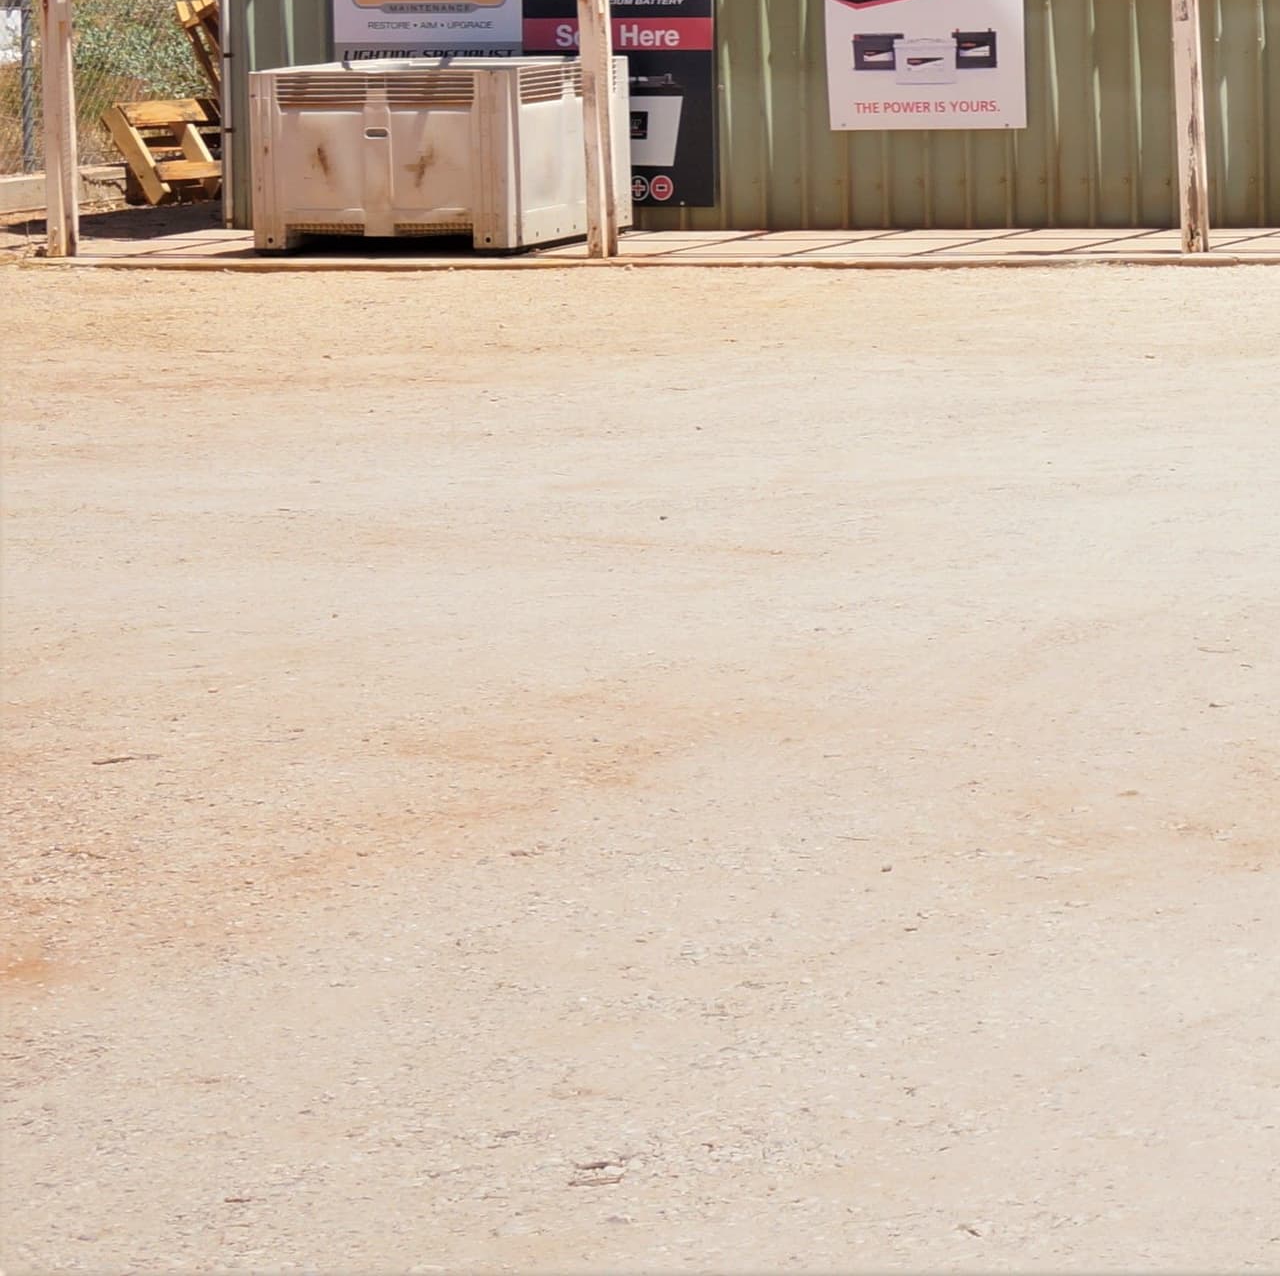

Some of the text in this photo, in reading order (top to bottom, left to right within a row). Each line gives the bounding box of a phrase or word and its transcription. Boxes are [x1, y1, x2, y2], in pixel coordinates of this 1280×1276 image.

[389, 3, 471, 13] MAINTENANCE
[368, 21, 411, 30] RESTORE
[447, 21, 494, 29] UPGRADE
[620, 25, 680, 47] Here
[855, 100, 1001, 113] THE POWER IS YOURS.
